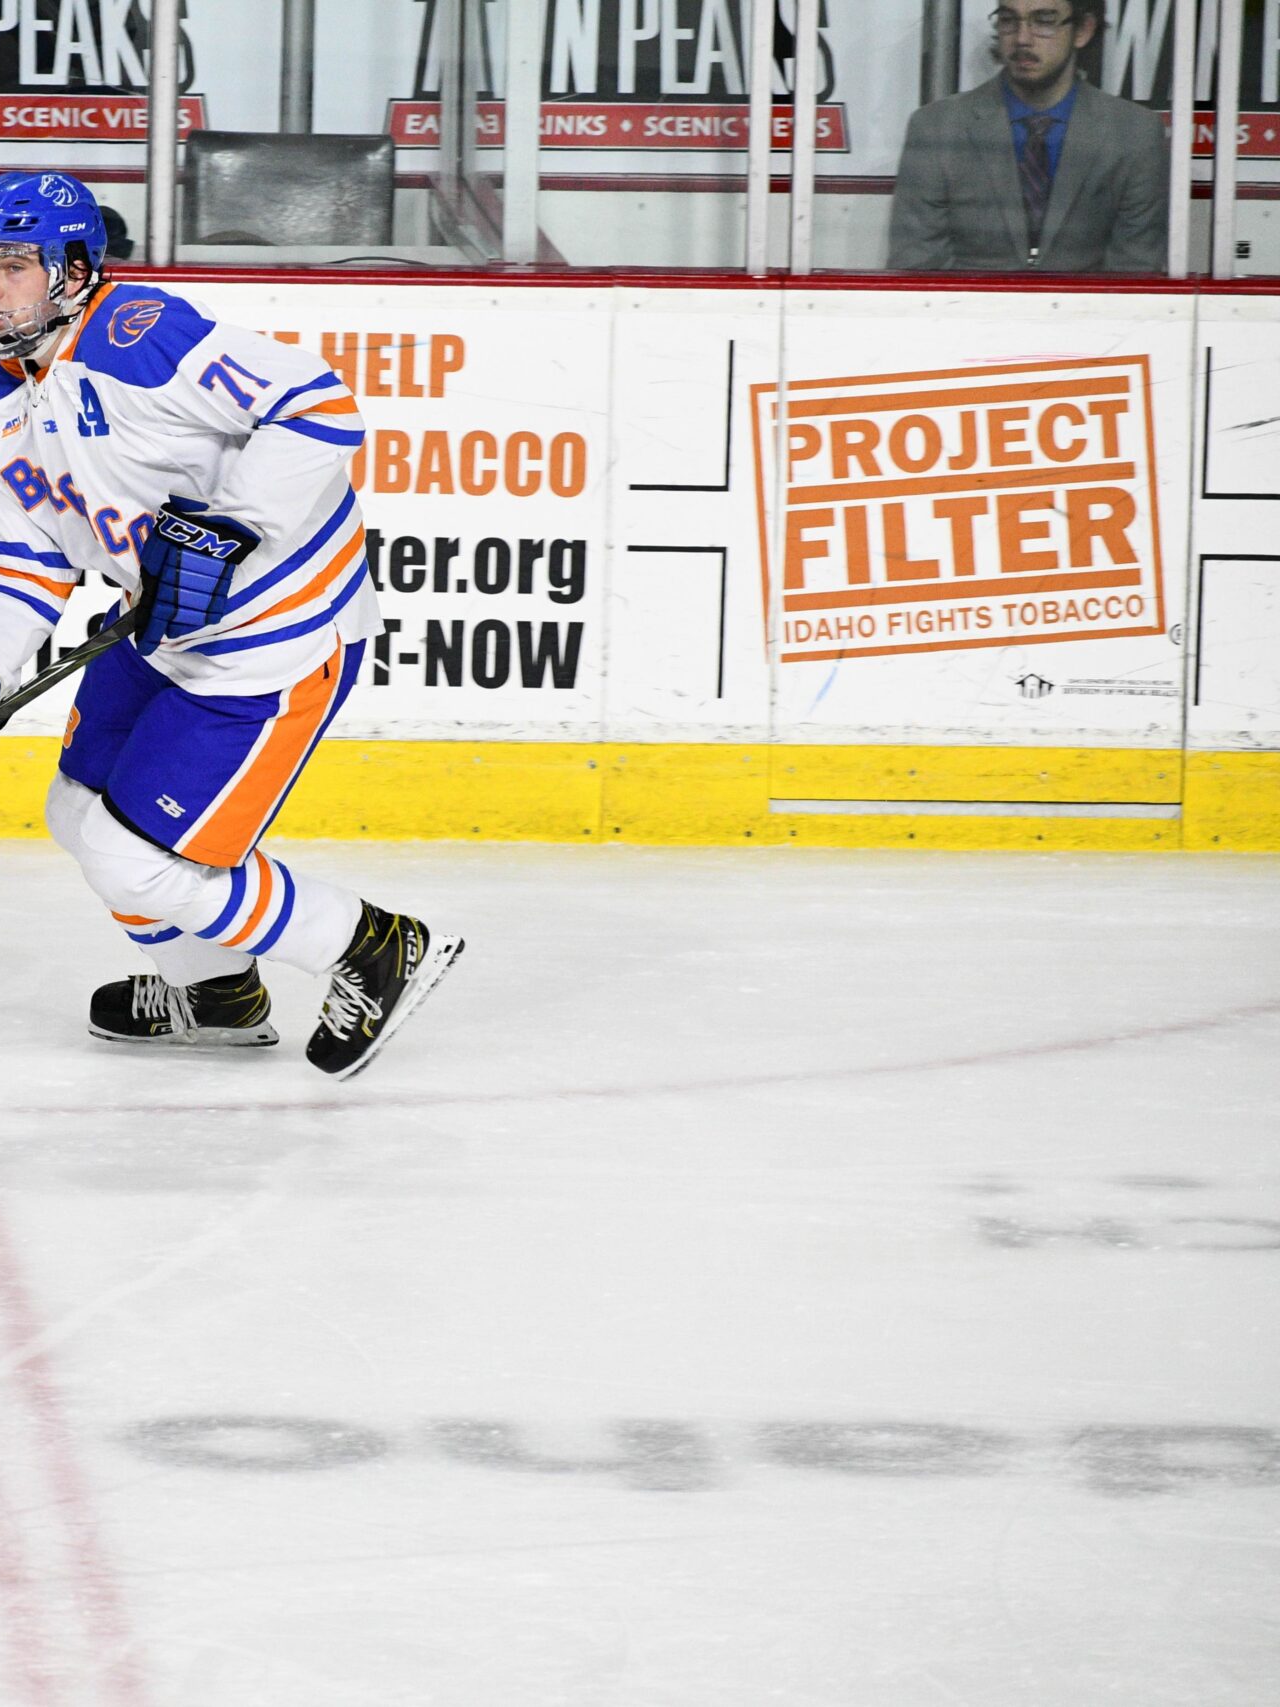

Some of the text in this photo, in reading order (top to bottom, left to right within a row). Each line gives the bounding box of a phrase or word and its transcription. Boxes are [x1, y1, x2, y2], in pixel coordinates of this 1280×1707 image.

[1, 107, 99, 129] SCENIC
[102, 108, 192, 129] VIES
[404, 114, 441, 134] EA
[537, 114, 608, 136] INKS
[643, 116, 739, 137] SCENIC
[60, 223, 86, 233] CCM
[197, 353, 272, 412] 71
[321, 332, 465, 398] HELP
[77, 377, 111, 437] A
[351, 429, 587, 498] BACCO
[786, 399, 1129, 483] PROJECT
[784, 486, 1139, 590] FILTER
[784, 594, 1144, 643] IDAHO FIGHTS TOBACCO
